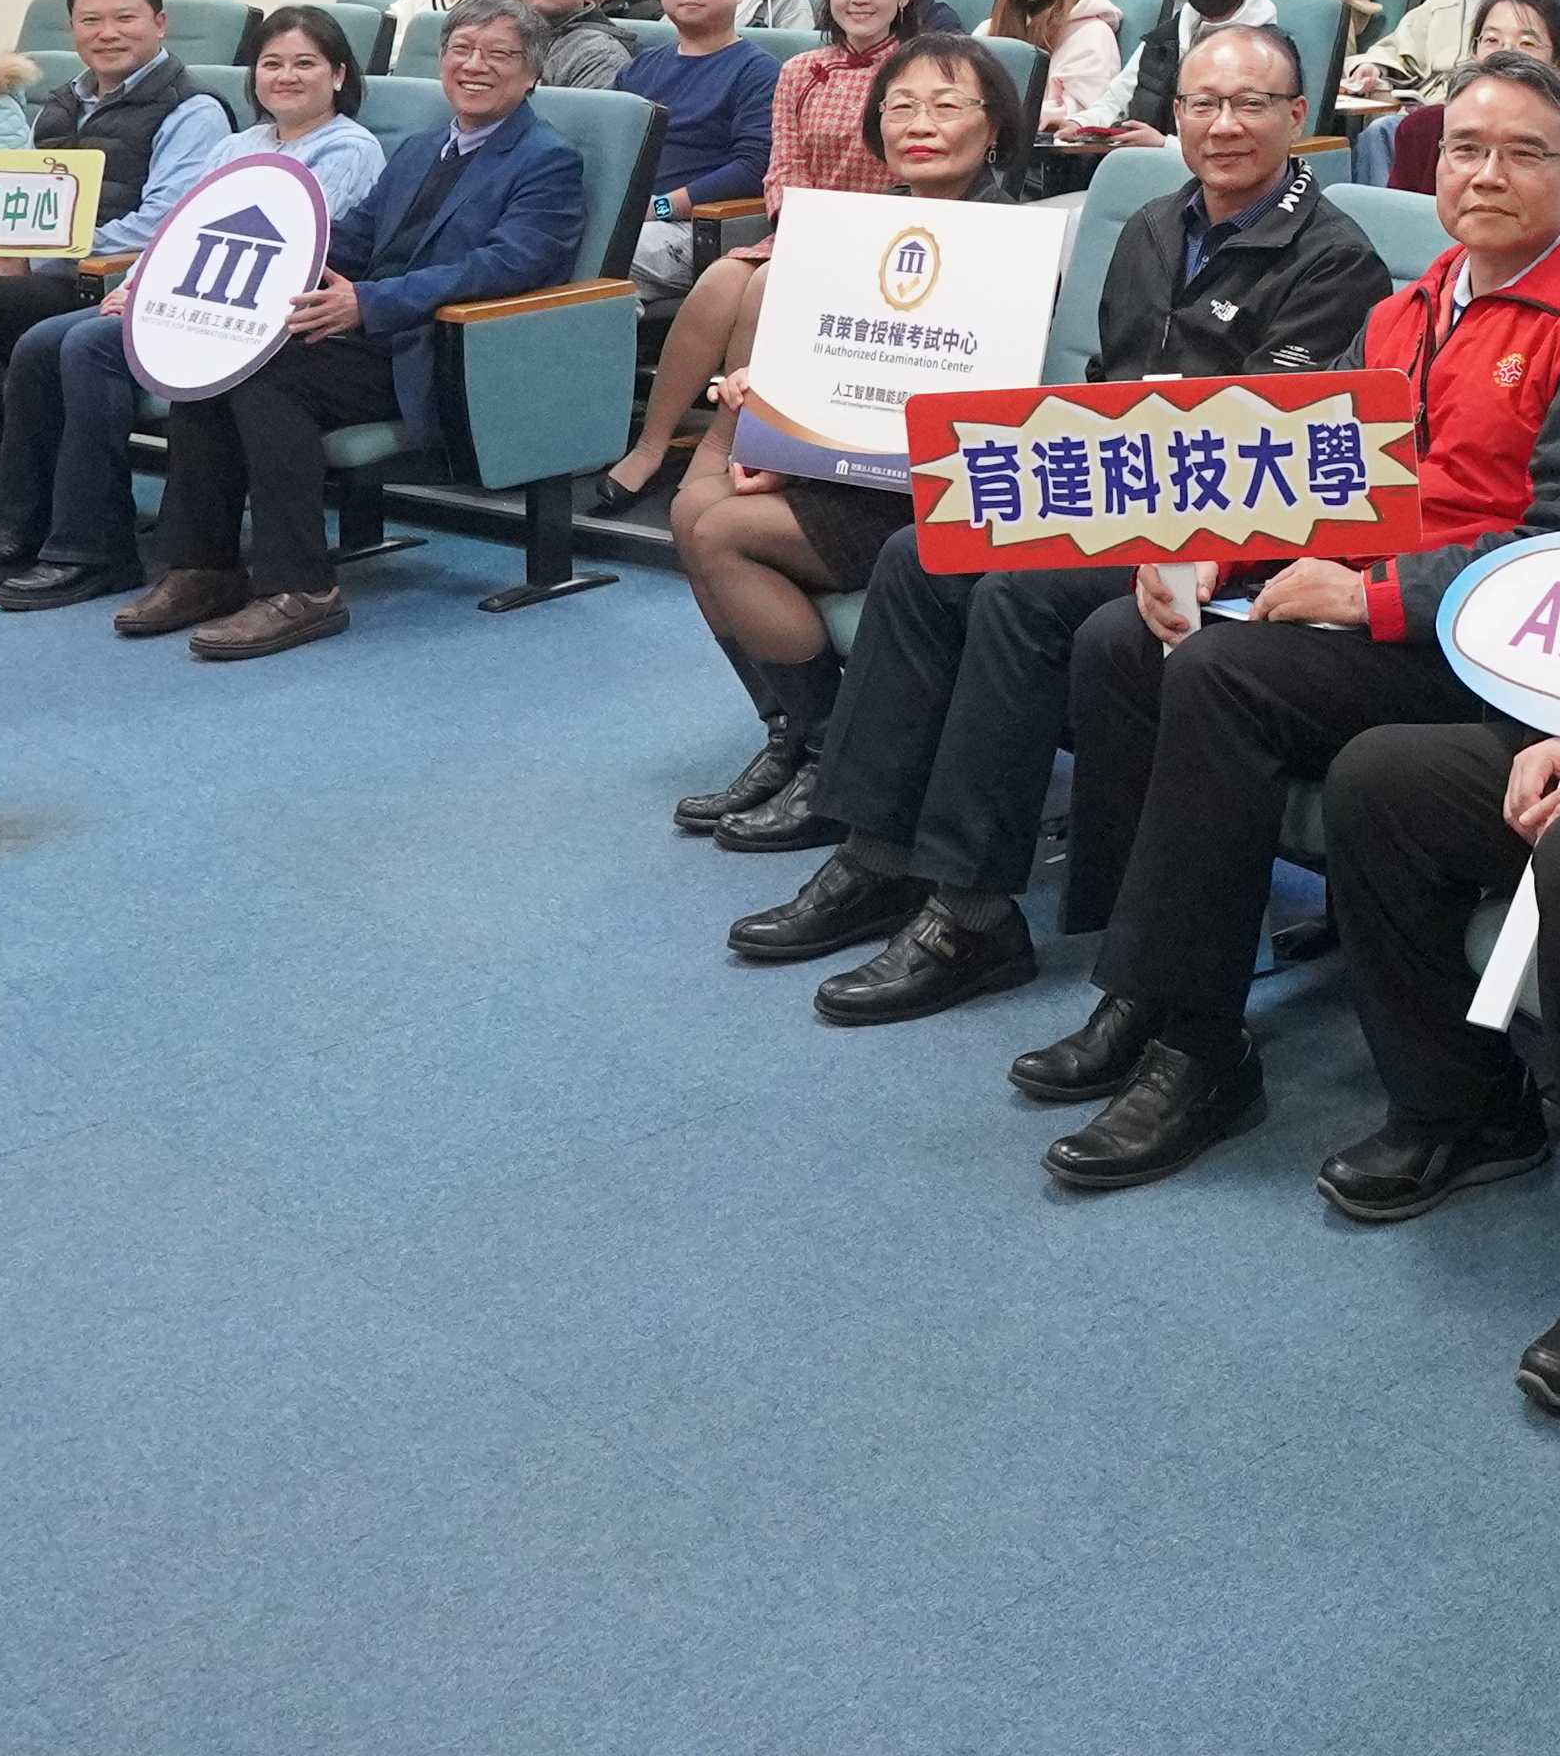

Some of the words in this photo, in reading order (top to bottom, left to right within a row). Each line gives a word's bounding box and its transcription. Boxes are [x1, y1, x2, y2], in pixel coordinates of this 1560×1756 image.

[817, 313, 978, 356] 資策會授權考試中心
[824, 343, 877, 362] Authorized
[878, 350, 939, 370] Examination
[940, 358, 974, 374] Center
[832, 382, 912, 405] 人工智慧職能認
[962, 421, 1367, 524] 育達科技大學
